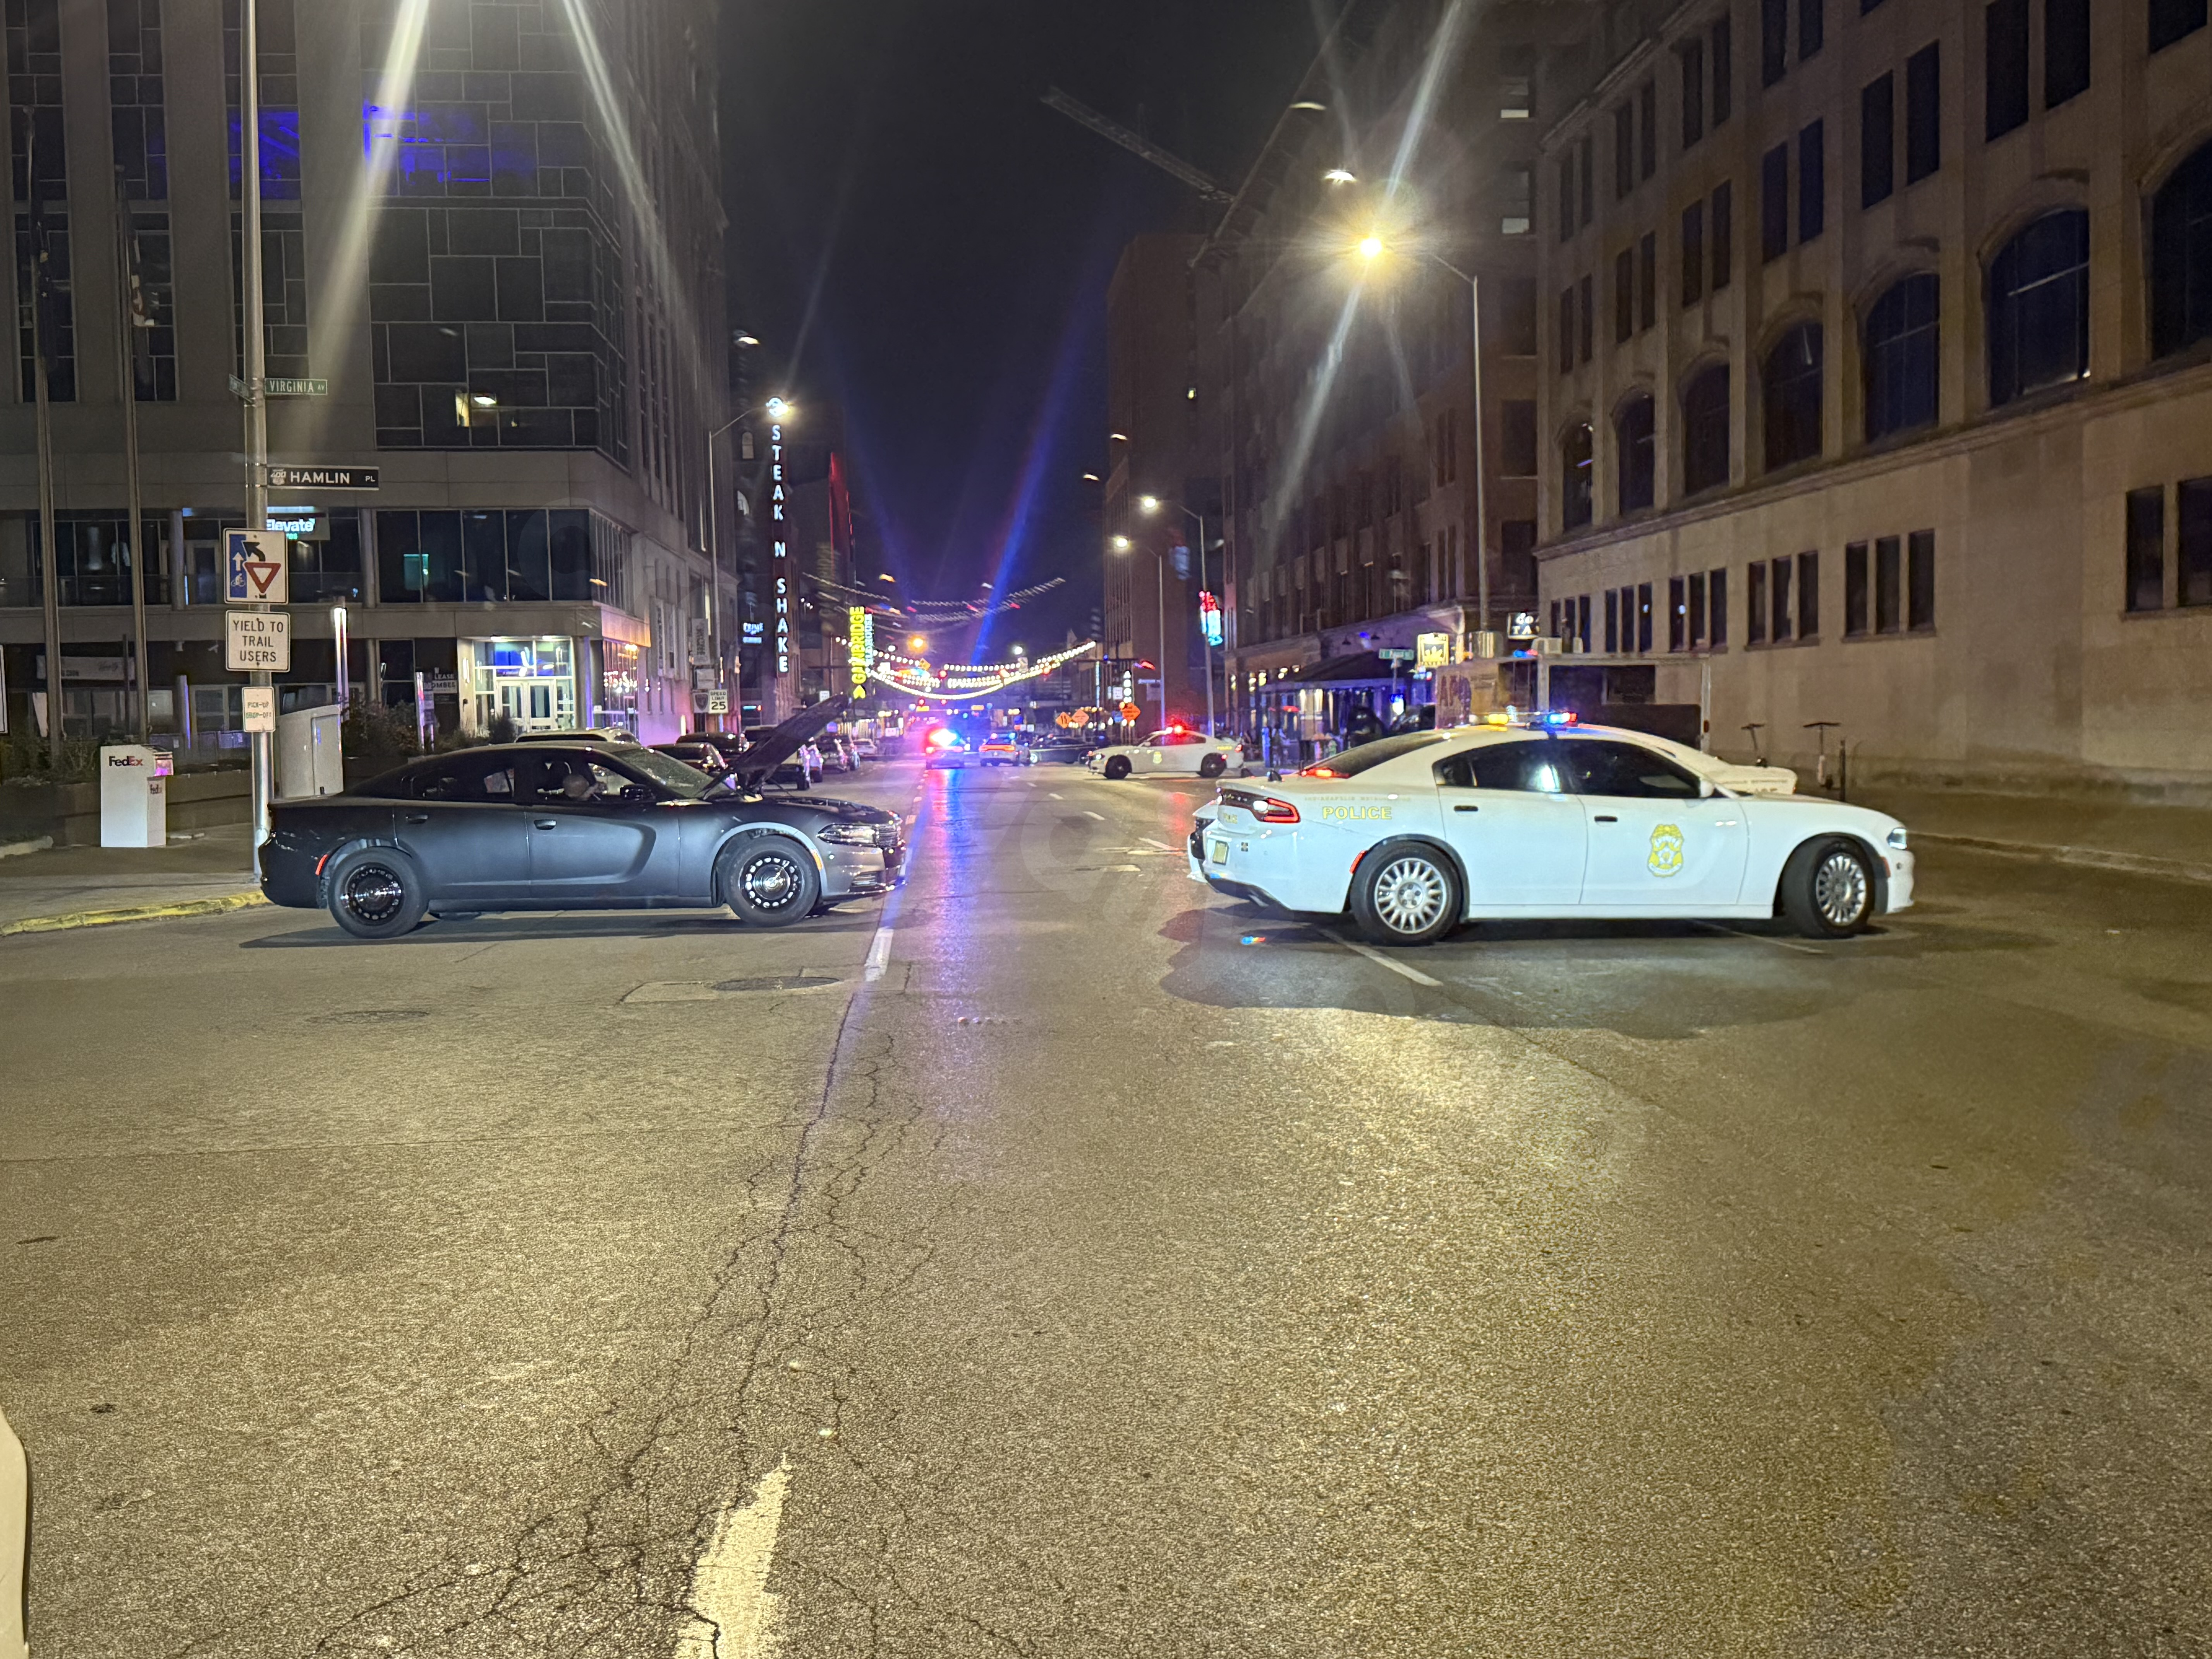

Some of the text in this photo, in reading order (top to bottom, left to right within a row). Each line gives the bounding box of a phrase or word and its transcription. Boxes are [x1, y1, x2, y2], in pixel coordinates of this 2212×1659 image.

[270, 380, 314, 393] VIRGINIA
[290, 471, 350, 484] HAMLIN
[772, 425, 788, 672] STEAK N SHAKE
[233, 620, 283, 632] YIELD TO
[242, 635, 273, 647] TRAIL
[240, 650, 276, 662] USERS
[711, 701, 726, 710] 25
[109, 756, 143, 766] FedEx
[1322, 806, 1392, 820] POLICE
